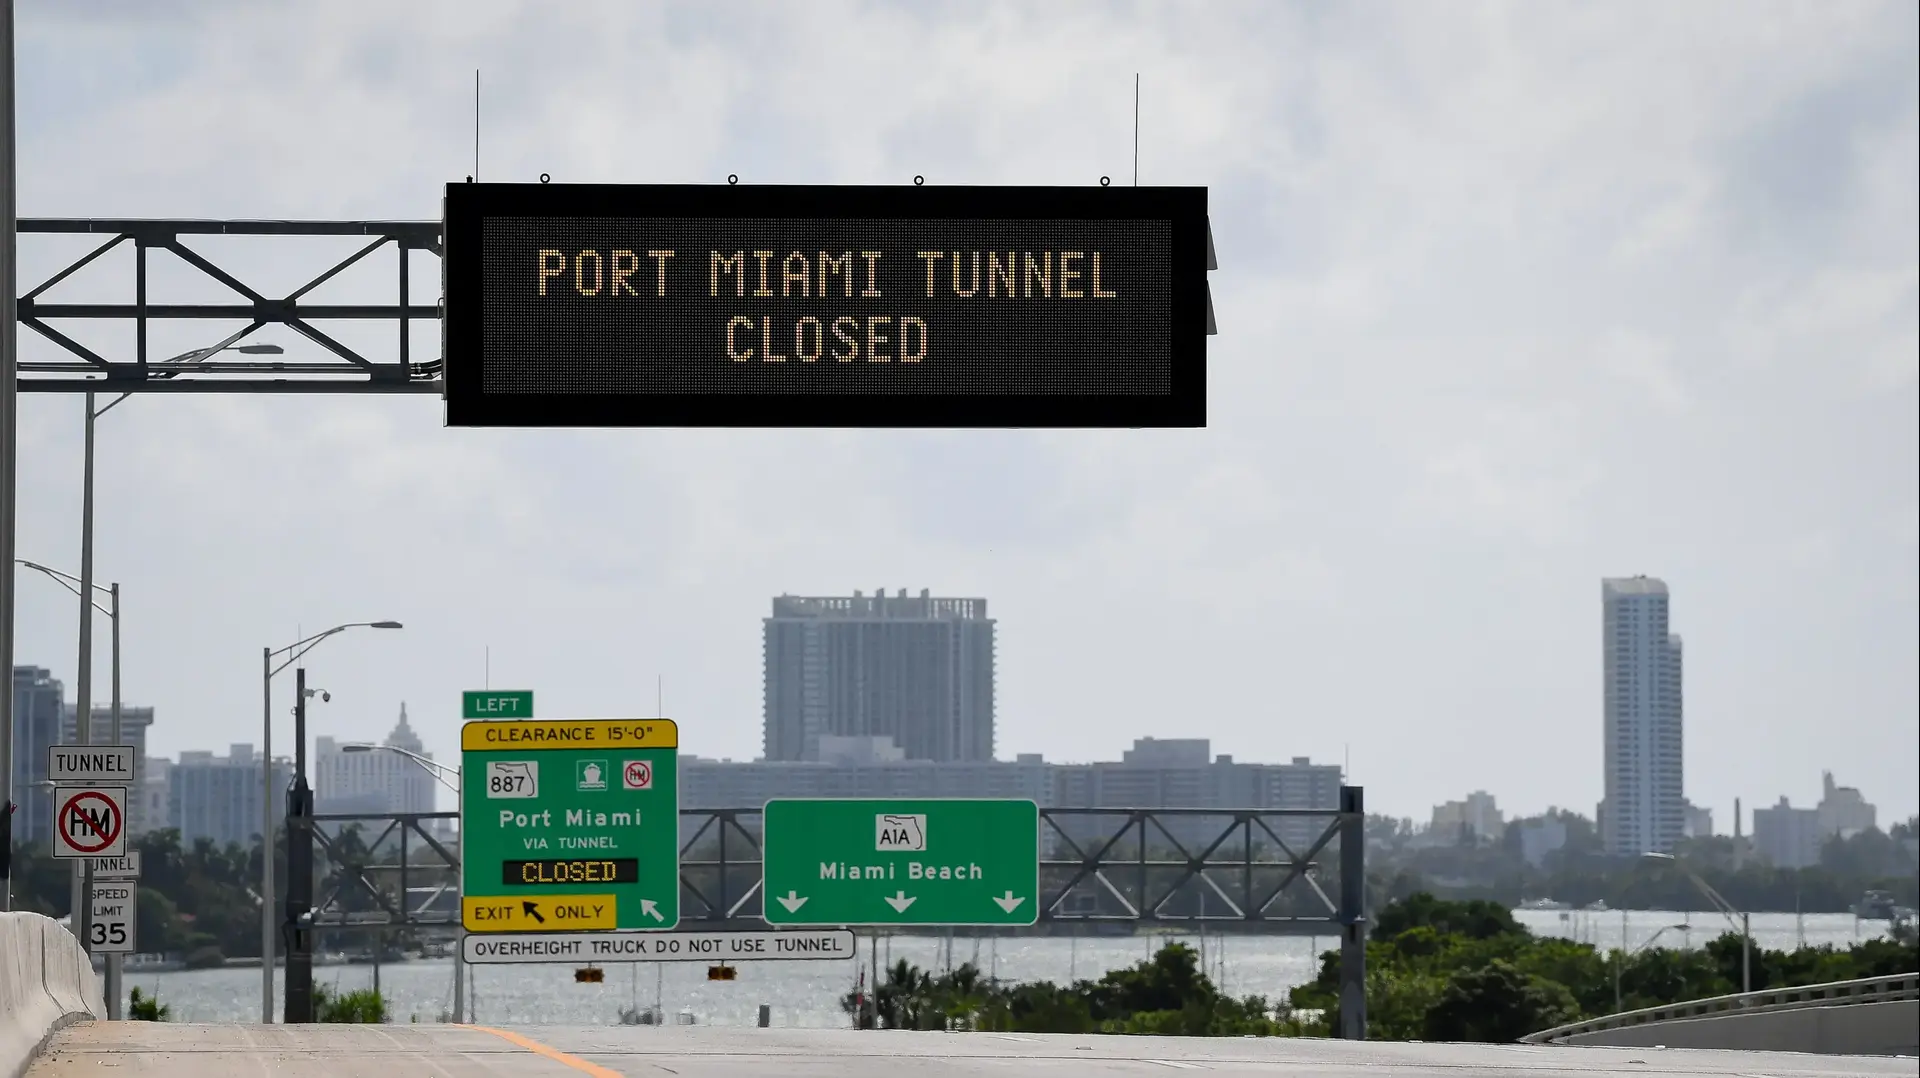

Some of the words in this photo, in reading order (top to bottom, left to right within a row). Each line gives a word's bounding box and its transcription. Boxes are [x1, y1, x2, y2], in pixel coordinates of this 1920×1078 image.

[538, 249, 674, 297] PORT
[710, 250, 883, 297] MIAMI
[917, 250, 1117, 298] TUNNEL
[726, 315, 929, 363] CLOSED
[476, 698, 519, 712] LEFT
[486, 728, 595, 742] CLEARANCE
[607, 727, 653, 740] 15'-0"
[57, 754, 127, 772] TUNNEL
[490, 776, 525, 793] 887
[70, 808, 112, 836] HM
[500, 810, 551, 828] Port
[566, 809, 642, 827] Miami
[523, 838, 548, 850] VIA
[559, 837, 618, 849] TUNNEL
[879, 829, 911, 845] A1A
[92, 858, 135, 871] UNNEL
[522, 861, 617, 883] CLOSED
[819, 862, 895, 880] Miami
[908, 862, 983, 880] Beach
[94, 906, 123, 916] LIMIT
[475, 907, 513, 920] EXIT
[555, 905, 604, 919] ONLY
[92, 923, 126, 945] 35
[475, 941, 582, 956] OVERHEIGHT
[591, 940, 647, 954] TRUCK
[656, 940, 680, 953] DO
[689, 939, 723, 953] NOT
[731, 939, 765, 952] USE
[775, 938, 842, 952] TUNNEL
